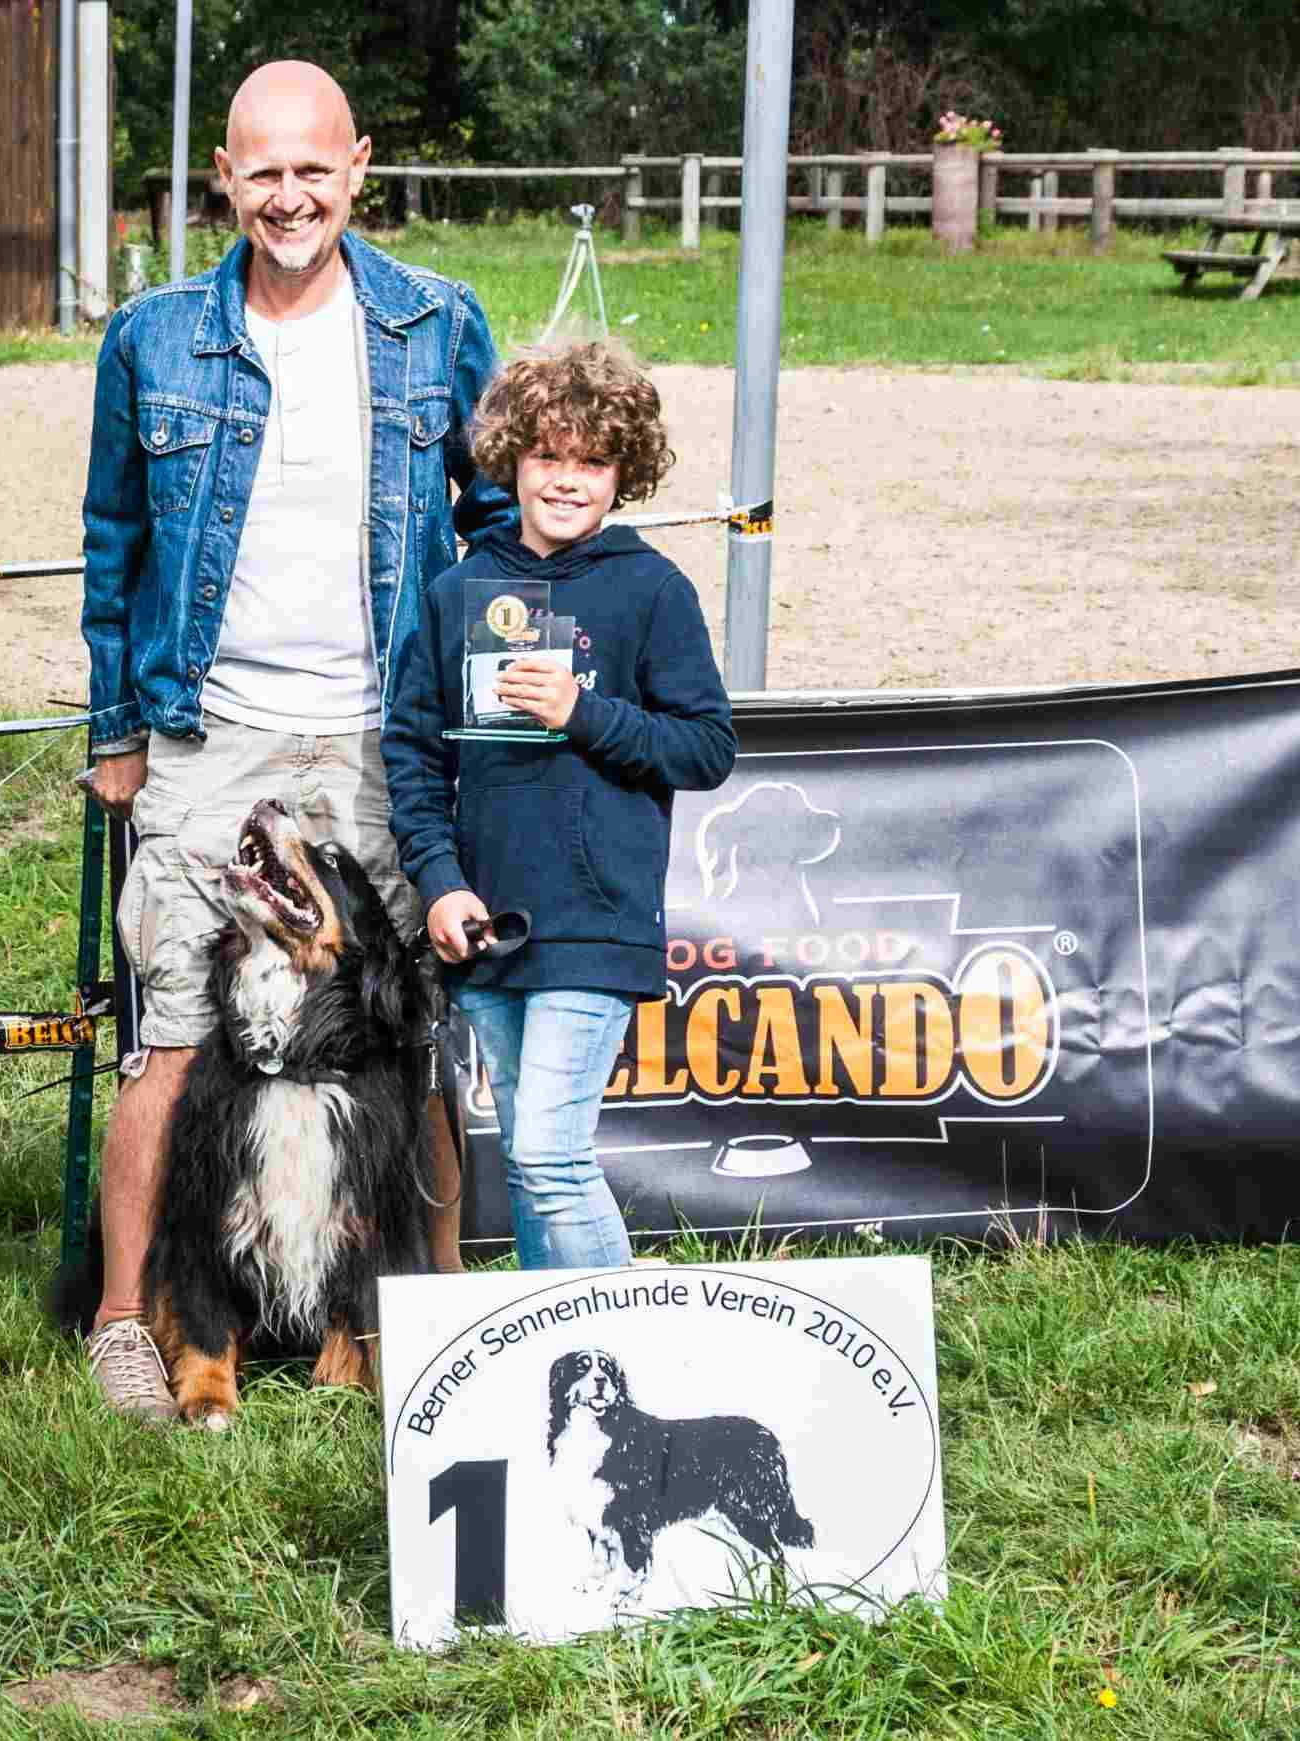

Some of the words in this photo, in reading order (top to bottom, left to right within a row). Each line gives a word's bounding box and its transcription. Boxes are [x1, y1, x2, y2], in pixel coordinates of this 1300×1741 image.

[667, 938, 737, 971] OG
[762, 931, 902, 967] FOOD
[407, 1349, 477, 1436] Berner
[480, 1279, 689, 1356] Sennenhunde
[701, 1280, 796, 1327] Verein
[803, 1310, 876, 1369] 2010
[871, 1368, 916, 1418] e.V.
[429, 1458, 508, 1626] 1
